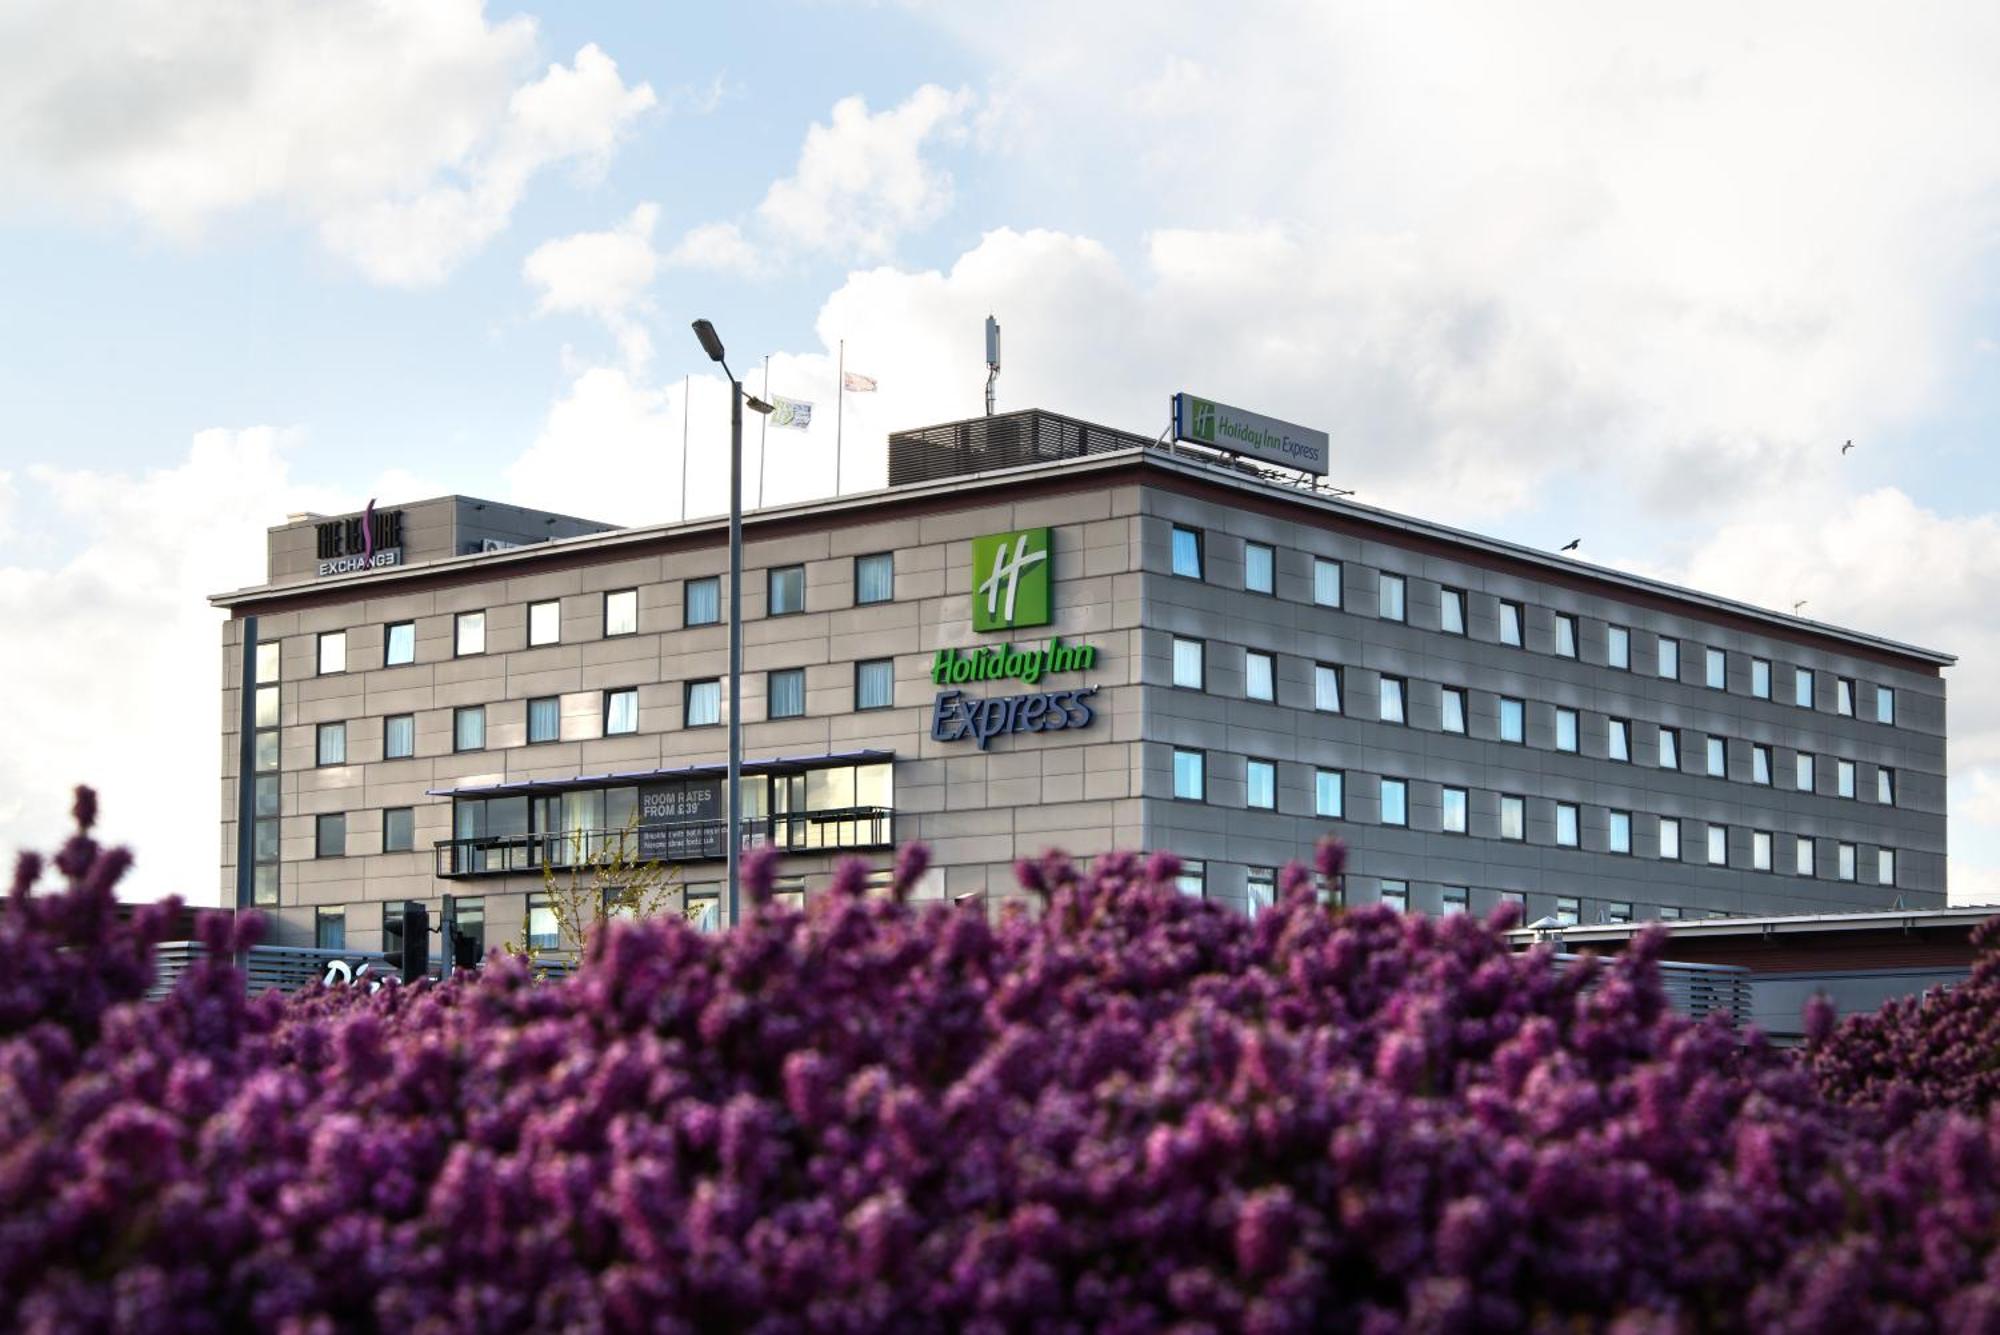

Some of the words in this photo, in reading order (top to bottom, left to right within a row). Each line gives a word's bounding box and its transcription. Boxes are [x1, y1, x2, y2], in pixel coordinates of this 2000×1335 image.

[1219, 416, 1263, 449] Holiday
[1264, 428, 1281, 449] Inn
[1282, 436, 1320, 461] Express
[314, 520, 344, 559] THE
[931, 642, 1046, 685] Holiday
[1047, 635, 1097, 673] Inn
[931, 686, 1098, 750] Express
[643, 804, 676, 817] FROM
[644, 794, 676, 806] ROOM
[678, 789, 712, 802] RATES
